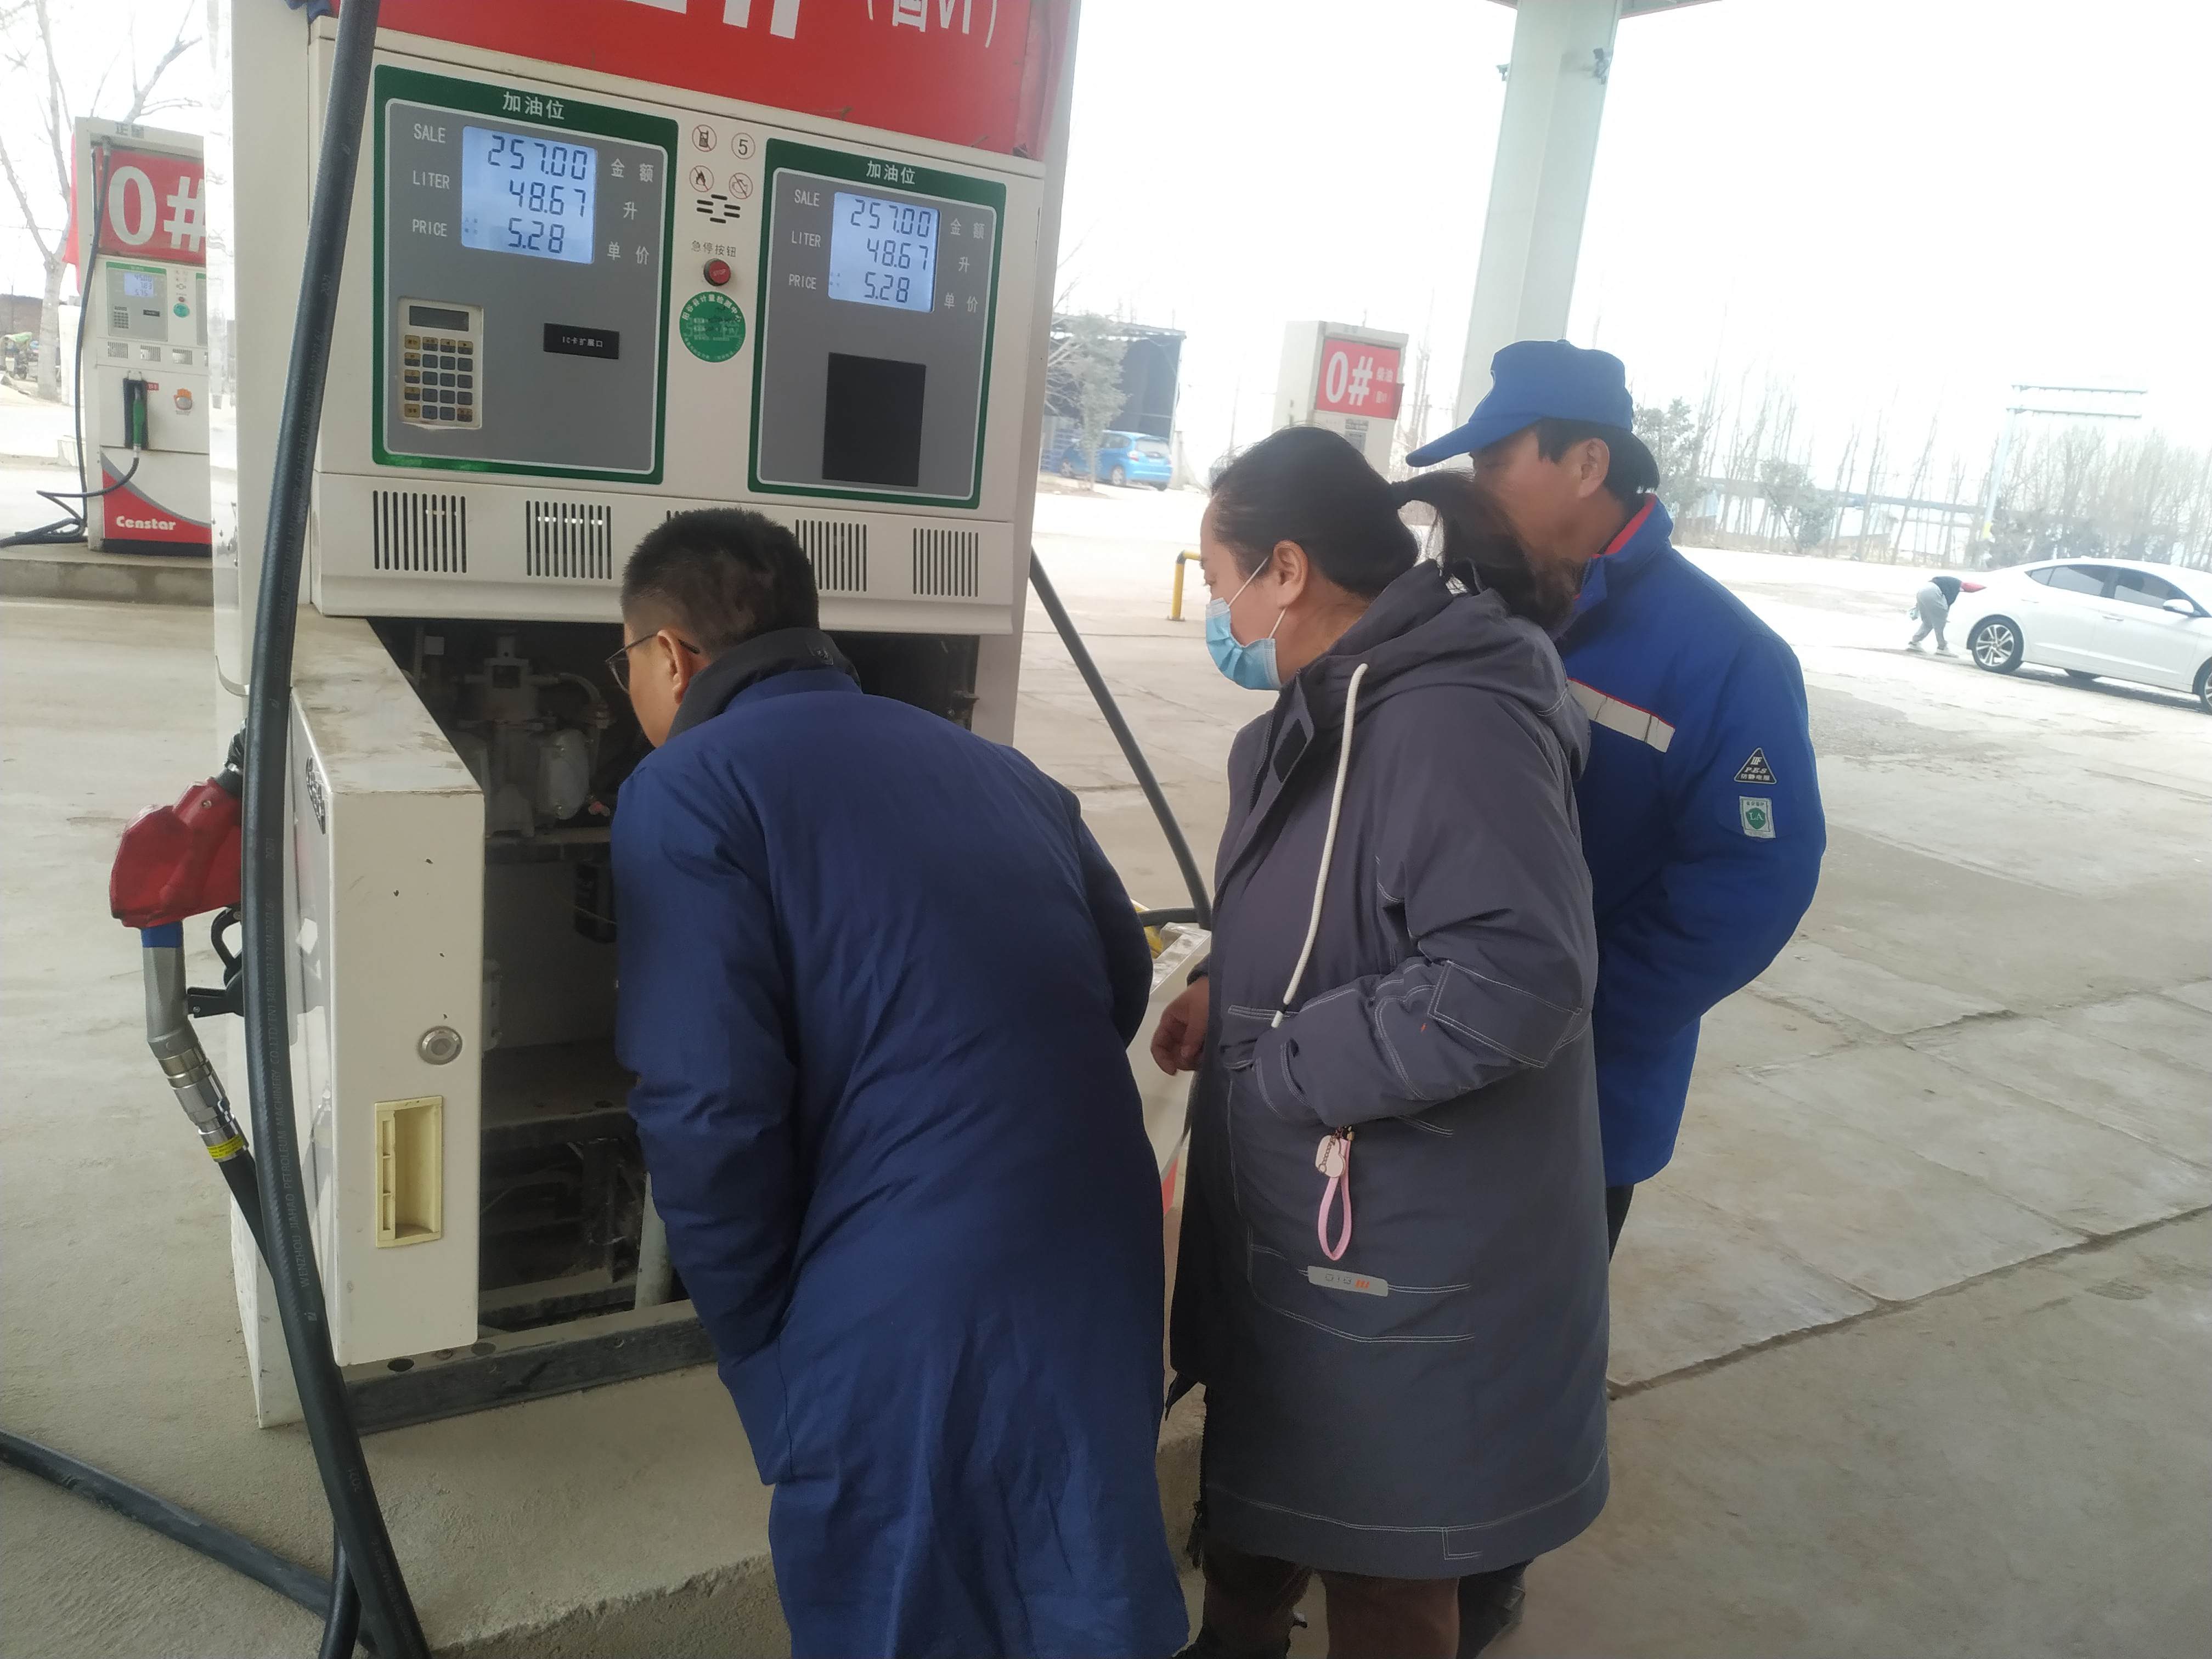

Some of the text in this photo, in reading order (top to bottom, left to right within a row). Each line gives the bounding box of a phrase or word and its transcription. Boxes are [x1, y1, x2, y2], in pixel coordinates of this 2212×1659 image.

[503, 91, 565, 120] 加油位
[413, 123, 446, 144] SALE
[488, 135, 588, 180] 257.00
[738, 139, 748, 156] 5
[413, 170, 450, 190] LITER
[611, 159, 653, 183] 金额
[866, 160, 916, 185] 加油位
[109, 166, 205, 252] 0#
[510, 180, 586, 217] 48.67
[794, 189, 820, 207] SALE
[623, 201, 637, 220] 升
[850, 199, 931, 238] 257.00
[412, 219, 448, 237] PRICE
[508, 218, 565, 253] 5.28
[792, 230, 821, 248] LITER
[950, 218, 985, 240] 金额
[607, 241, 650, 266] 单价
[691, 240, 736, 257] 急停按钮
[867, 238, 928, 271] 48.67
[958, 257, 970, 272] 升
[788, 273, 816, 290] PRICE
[865, 271, 910, 304] 5.28
[944, 294, 978, 314] 单价
[1326, 351, 1373, 406] 0#
[1749, 812, 1764, 821] LA
[272, 1070, 284, 1126] MACHINERY
[278, 1131, 291, 1188] PETROLEUM
[295, 1235, 309, 1287] WENZHOU
